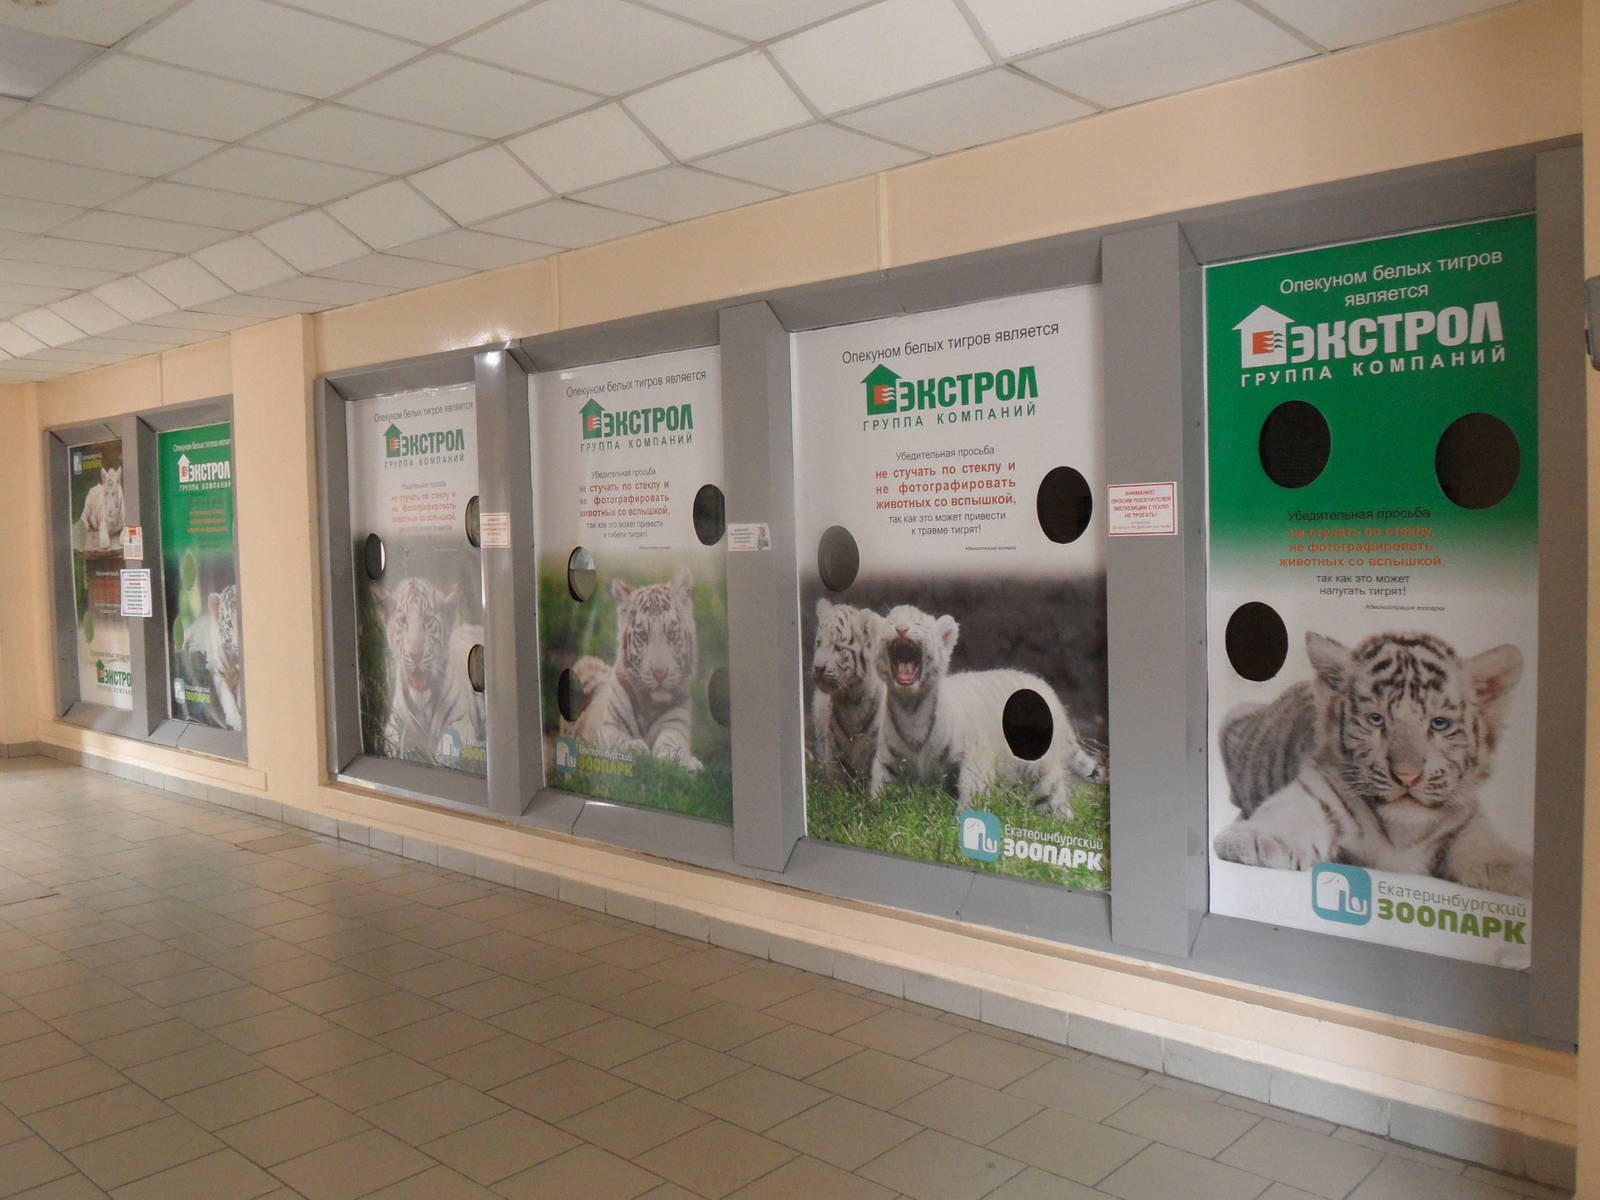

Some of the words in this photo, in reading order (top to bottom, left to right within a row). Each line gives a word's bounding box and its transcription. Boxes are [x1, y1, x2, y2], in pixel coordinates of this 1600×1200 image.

[1280, 270, 1367, 295] Опекуном
[1372, 261, 1432, 281] белых
[1438, 250, 1504, 272] тигров
[1344, 283, 1429, 307] является
[1290, 301, 1504, 364] ЭКСТРОЛ
[842, 346, 901, 364] Опекуном
[904, 341, 944, 356] белых
[948, 335, 991, 350] тигров
[995, 323, 1059, 342] является
[1241, 365, 1332, 388] ГРУППА
[1353, 345, 1505, 377] КОМПАНИЙ
[566, 384, 605, 399] Опекуном
[606, 380, 633, 393] белых
[635, 376, 664, 388] тигров
[665, 370, 706, 384] является
[900, 365, 1038, 412] ЭКСТРОЛ
[603, 403, 694, 438] ЭКСТРОЛ
[863, 417, 924, 432] ГРУППА
[937, 401, 1036, 425] КОМПАНИЙ
[401, 428, 465, 457] ЭКСТРОЛ
[580, 441, 621, 452] ГРУППА
[628, 431, 693, 448] КОМПАНИЙ
[896, 449, 956, 461] Убедительная
[957, 445, 995, 458] просьба
[189, 461, 231, 482] ЭКСТРОЛ
[875, 470, 888, 478] не
[893, 466, 936, 480] стучать
[942, 465, 956, 475] по
[962, 462, 1002, 474] стеклу
[1008, 462, 1016, 470] и
[589, 484, 619, 494] стучать
[622, 482, 632, 490] по
[635, 480, 661, 491] стеклу
[876, 485, 889, 494] не
[898, 478, 1016, 495] фотографировать
[593, 493, 670, 506] фотографировать
[876, 500, 931, 509] животных
[934, 497, 948, 507] со
[889, 515, 902, 523] так
[904, 514, 917, 523] как
[919, 514, 933, 522] это
[935, 512, 962, 522] может
[964, 511, 1006, 522] привести
[1287, 510, 1373, 521] Убедительная
[1377, 506, 1431, 520] просьба
[918, 526, 949, 537] травме
[951, 525, 982, 536] тигрят!
[1307, 541, 1435, 555] фотографировать
[1279, 558, 1344, 567] животных
[1349, 558, 1364, 566] со
[1316, 575, 1332, 584] так
[1335, 575, 1352, 584] как
[1355, 574, 1373, 583] это
[1376, 574, 1410, 583] может
[1319, 587, 1365, 597] напугать
[1369, 586, 1407, 597] тигрят!
[104, 669, 132, 687] ЭКСТРО
[1004, 823, 1104, 850] Екатеринбургский
[1003, 838, 1104, 872] ЗООПАРК
[1378, 881, 1526, 918] Екатеринбургский
[1377, 898, 1527, 945] ЗООПАРК
